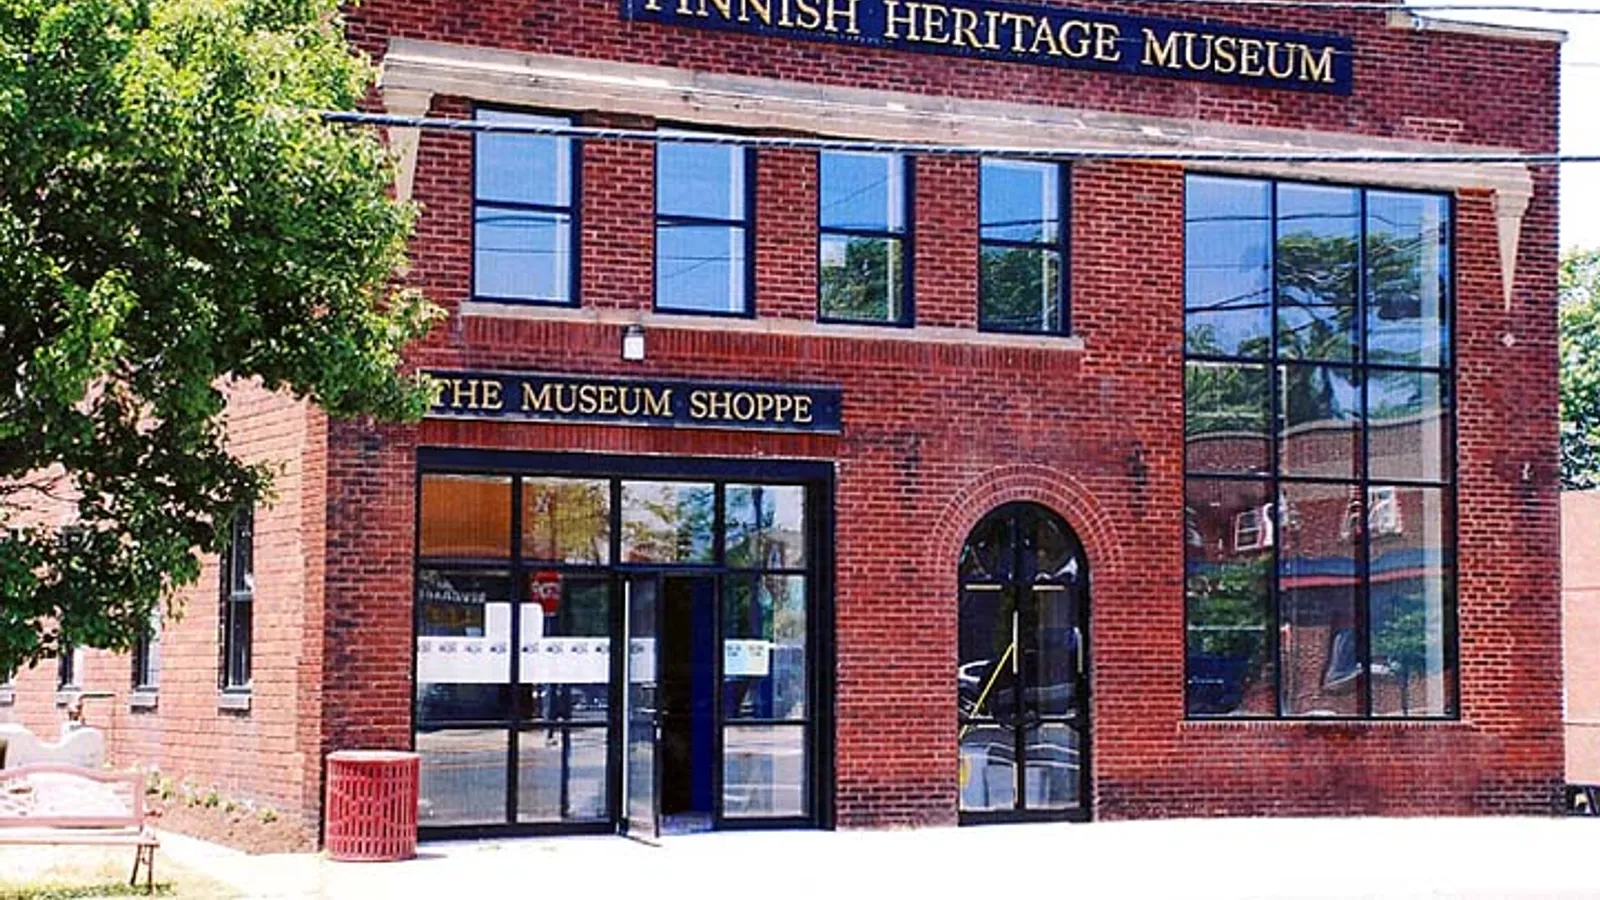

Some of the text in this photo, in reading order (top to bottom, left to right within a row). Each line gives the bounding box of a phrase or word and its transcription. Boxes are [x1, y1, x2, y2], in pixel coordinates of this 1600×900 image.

[644, 0, 1336, 83] NNISH HERITAGE MUSEUM
[430, 379, 813, 423] THE MUSEUM SHOPPE
